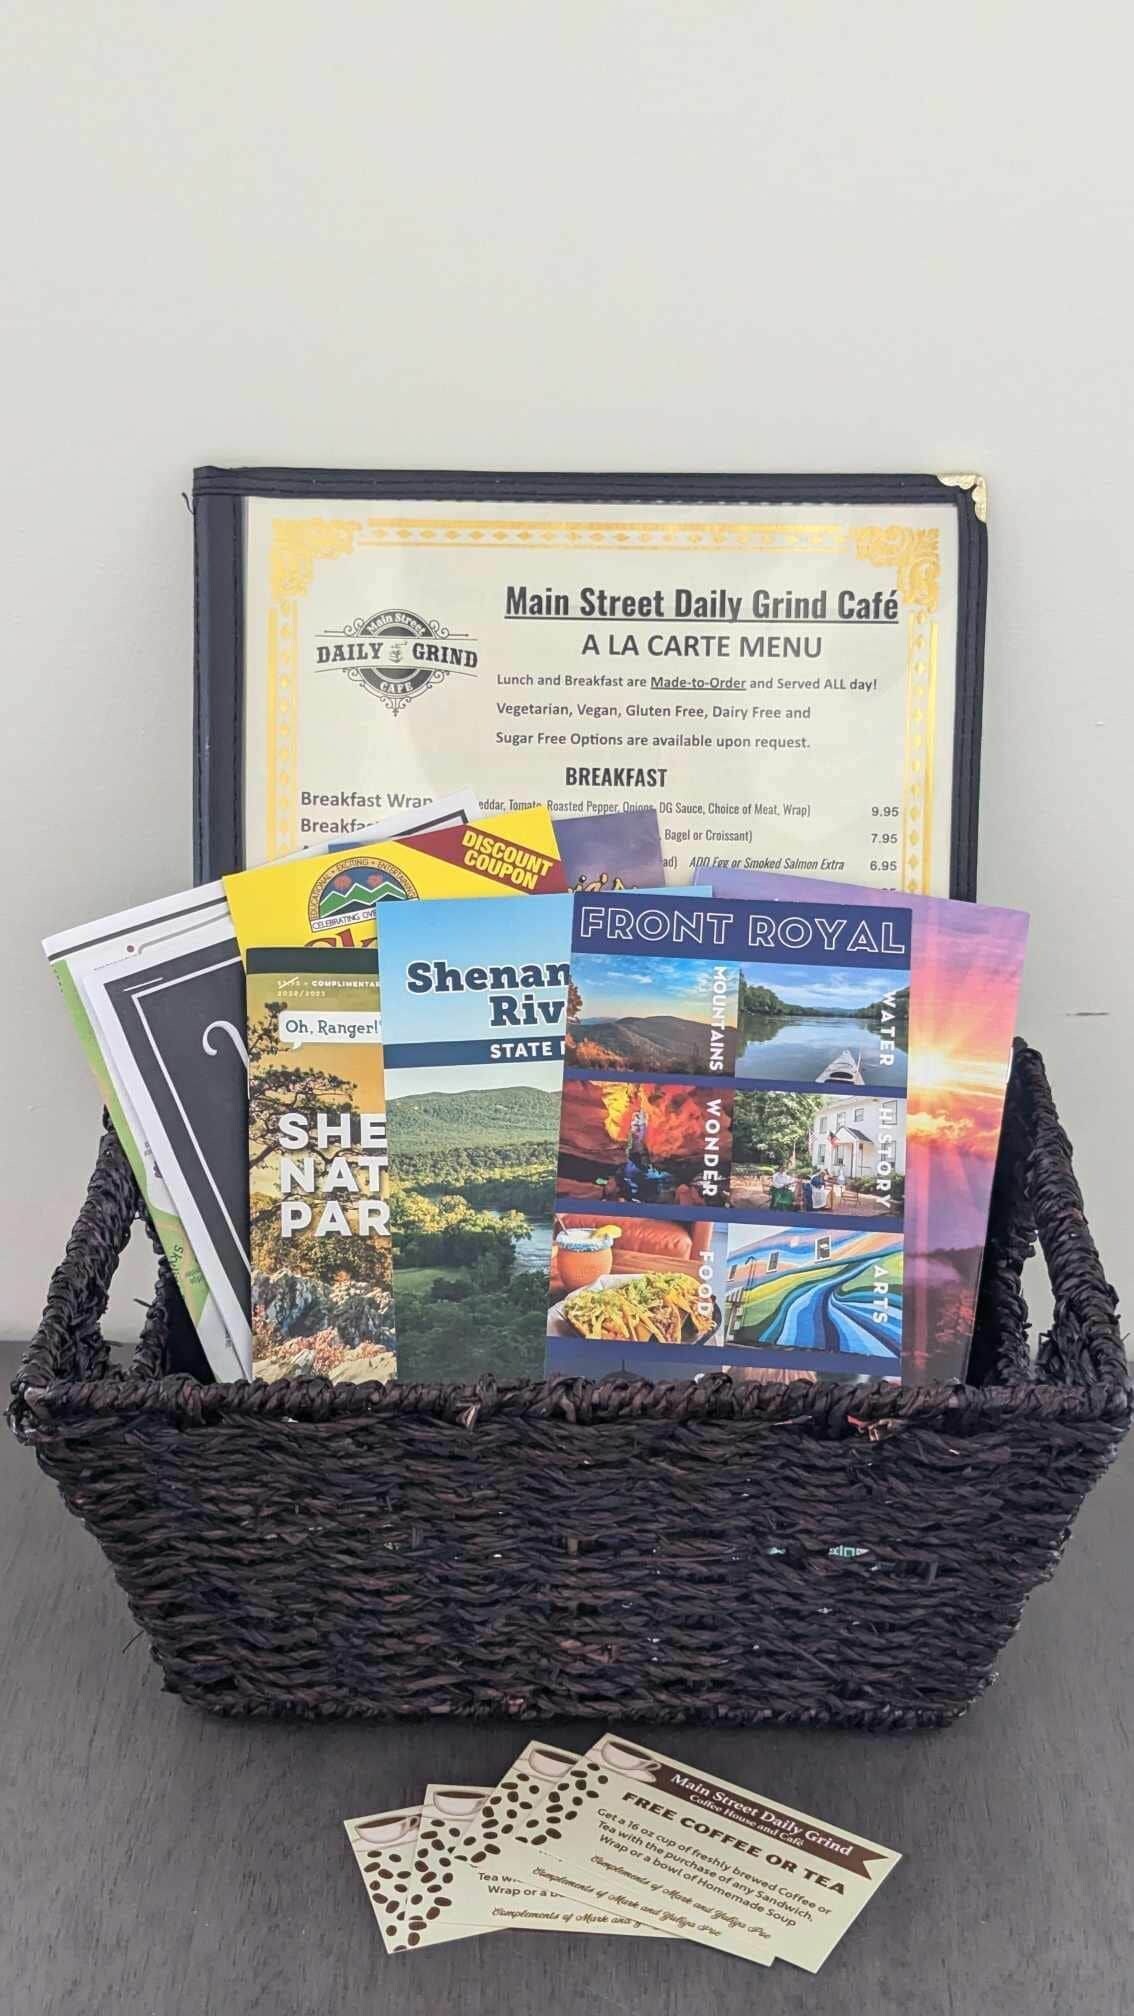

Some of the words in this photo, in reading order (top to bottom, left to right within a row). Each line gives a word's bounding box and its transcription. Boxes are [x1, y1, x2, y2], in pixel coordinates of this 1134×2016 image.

[505, 586, 570, 616] Main
[579, 588, 665, 617] Street
[675, 589, 743, 622] Daily
[752, 590, 828, 619] Grind
[837, 589, 899, 620] Café
[366, 614, 394, 636] Main
[394, 613, 426, 636] Street
[316, 642, 383, 664] DAILY
[412, 642, 479, 669] GRIND
[581, 634, 600, 655] A
[608, 634, 640, 656] LA
[647, 635, 730, 657] CARTE
[740, 636, 823, 658] MENU
[497, 674, 534, 687] Lunch
[537, 674, 562, 687] and
[565, 674, 624, 688] Breakfast
[627, 678, 647, 688] are
[650, 676, 747, 691] Made-to-Order
[750, 677, 774, 690] and
[777, 677, 821, 690] Served
[824, 678, 847, 691] ALL
[849, 678, 878, 693] day!
[496, 702, 574, 717] Vegetarian,
[577, 704, 623, 718] Vegan,
[625, 704, 672, 718] Gluten
[675, 705, 709, 720] Free,
[712, 705, 749, 721] Dairy
[752, 706, 782, 719] Free
[785, 706, 811, 719] and
[496, 731, 534, 747] Sugar
[537, 732, 567, 745] Free
[570, 733, 624, 749] Options
[626, 736, 649, 747] are
[652, 734, 713, 748] available
[716, 737, 752, 752] upon
[754, 736, 811, 752] request.
[565, 767, 668, 789] BREAKFAST
[301, 791, 382, 808] Breakfast
[547, 801, 584, 812] Roasted
[659, 802, 673, 813] DG
[675, 802, 706, 815] Sauce,
[708, 803, 740, 815] Choice
[742, 803, 752, 815] of
[754, 804, 780, 816] Meat,
[783, 804, 811, 818] Wrap)
[871, 806, 900, 817] 9.95
[664, 829, 691, 843] Bagel
[693, 831, 704, 841] or
[705, 829, 753, 843] Croissant)
[871, 833, 898, 844] 7.95
[462, 830, 553, 877] DISCOUNT
[731, 858, 742, 868] or
[744, 857, 781, 870] Smoked
[783, 858, 818, 870] Salmon
[820, 859, 845, 870] Extra
[870, 860, 897, 871] 6.95
[463, 849, 539, 890] COUPON
[312, 912, 361, 929] CELEBRATING
[580, 906, 733, 945] FRONT
[747, 914, 906, 954] ROYAL
[489, 994, 565, 1027] Riv
[709, 965, 728, 1071] MOUNTAINS
[285, 1019, 314, 1034] Oh,
[879, 991, 897, 1066] WATER
[490, 1041, 553, 1059] STATE
[278, 1112, 388, 1149] SHE
[701, 1098, 722, 1198] WONDER
[875, 1108, 893, 1209] HISTORY
[280, 1155, 389, 1193] NAT
[280, 1200, 391, 1237] PAR
[697, 1250, 714, 1318] FOOD
[871, 1265, 890, 1324] ARTS
[670, 1773, 711, 1797] Main
[712, 1791, 760, 1817] Street
[759, 1810, 803, 1836] Daily
[804, 1829, 855, 1857] Grind
[689, 1793, 724, 1814] Coffee
[723, 1808, 757, 1827] House
[756, 1822, 779, 1836] and
[622, 1791, 678, 1821] FREE
[679, 1817, 763, 1858] COFFEE
[765, 1854, 800, 1874] OR
[802, 1868, 846, 1896] TEA
[597, 1808, 618, 1822] Get
[617, 1817, 626, 1825] a
[627, 1820, 641, 1831] 16
[640, 1827, 655, 1838] oz
[655, 1834, 677, 1848] cup
[677, 1843, 693, 1854] of
[692, 1848, 732, 1872] freshly
[732, 1866, 778, 1891] brewed
[778, 1887, 817, 1909] Coffee
[817, 1905, 832, 1915] or
[598, 1819, 617, 1834] Tea
[618, 1828, 644, 1846] with
[644, 1841, 665, 1855] the
[663, 1851, 718, 1878] purchase
[718, 1874, 734, 1885] of
[731, 1881, 755, 1897] any
[754, 1890, 814, 1922] Sandwich,
[479, 1872, 499, 1882] Tea
[488, 1885, 521, 1897] Wrap
[523, 1888, 537, 1897] or
[599, 1833, 629, 1853] Wrap
[629, 1849, 643, 1858] or
[643, 1855, 652, 1863] a
[652, 1857, 684, 1876] bowl
[683, 1873, 699, 1882] of
[697, 1877, 765, 1913] Homemade
[765, 1907, 797, 1927] Soup
[575, 1911, 609, 1924] Mark
